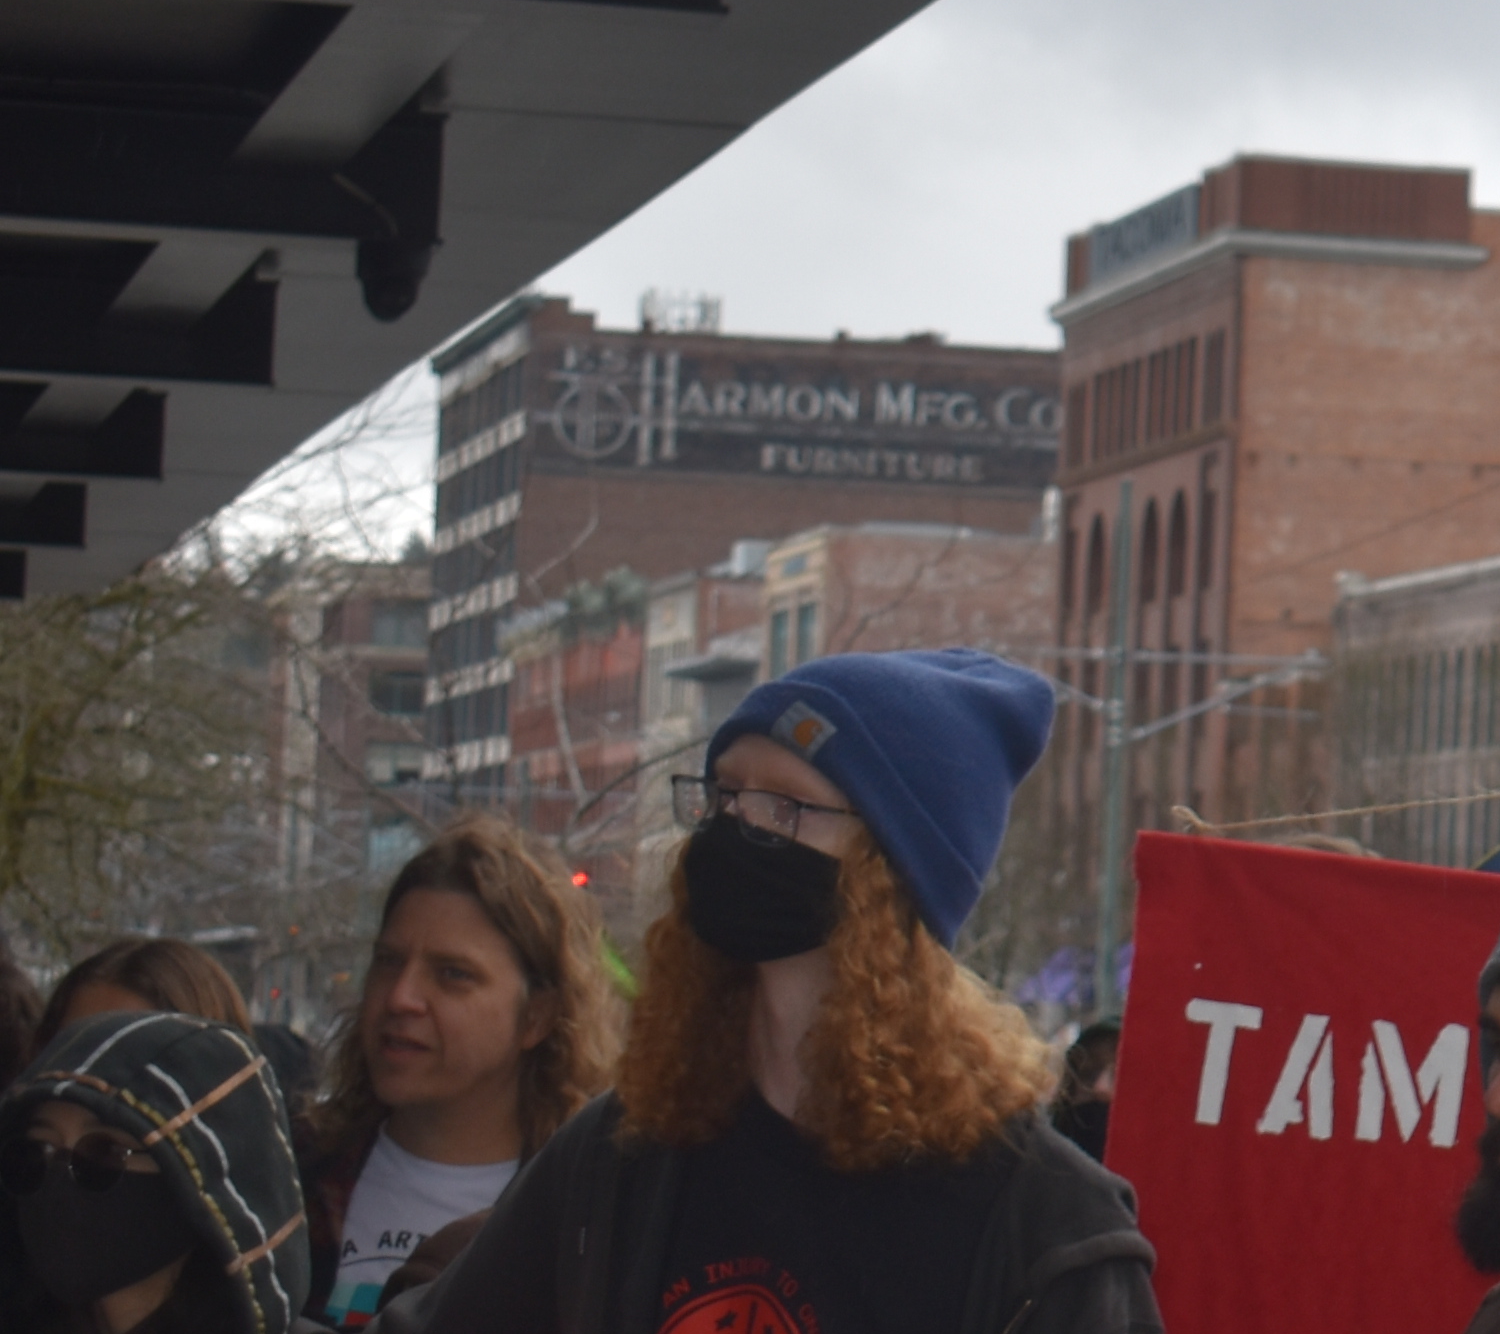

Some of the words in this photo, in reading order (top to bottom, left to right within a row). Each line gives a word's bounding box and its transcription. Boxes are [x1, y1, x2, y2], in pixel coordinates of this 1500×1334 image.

[637, 348, 860, 465] HARMON
[760, 442, 982, 483] FURNITURE
[1185, 998, 1470, 1148] TAM
